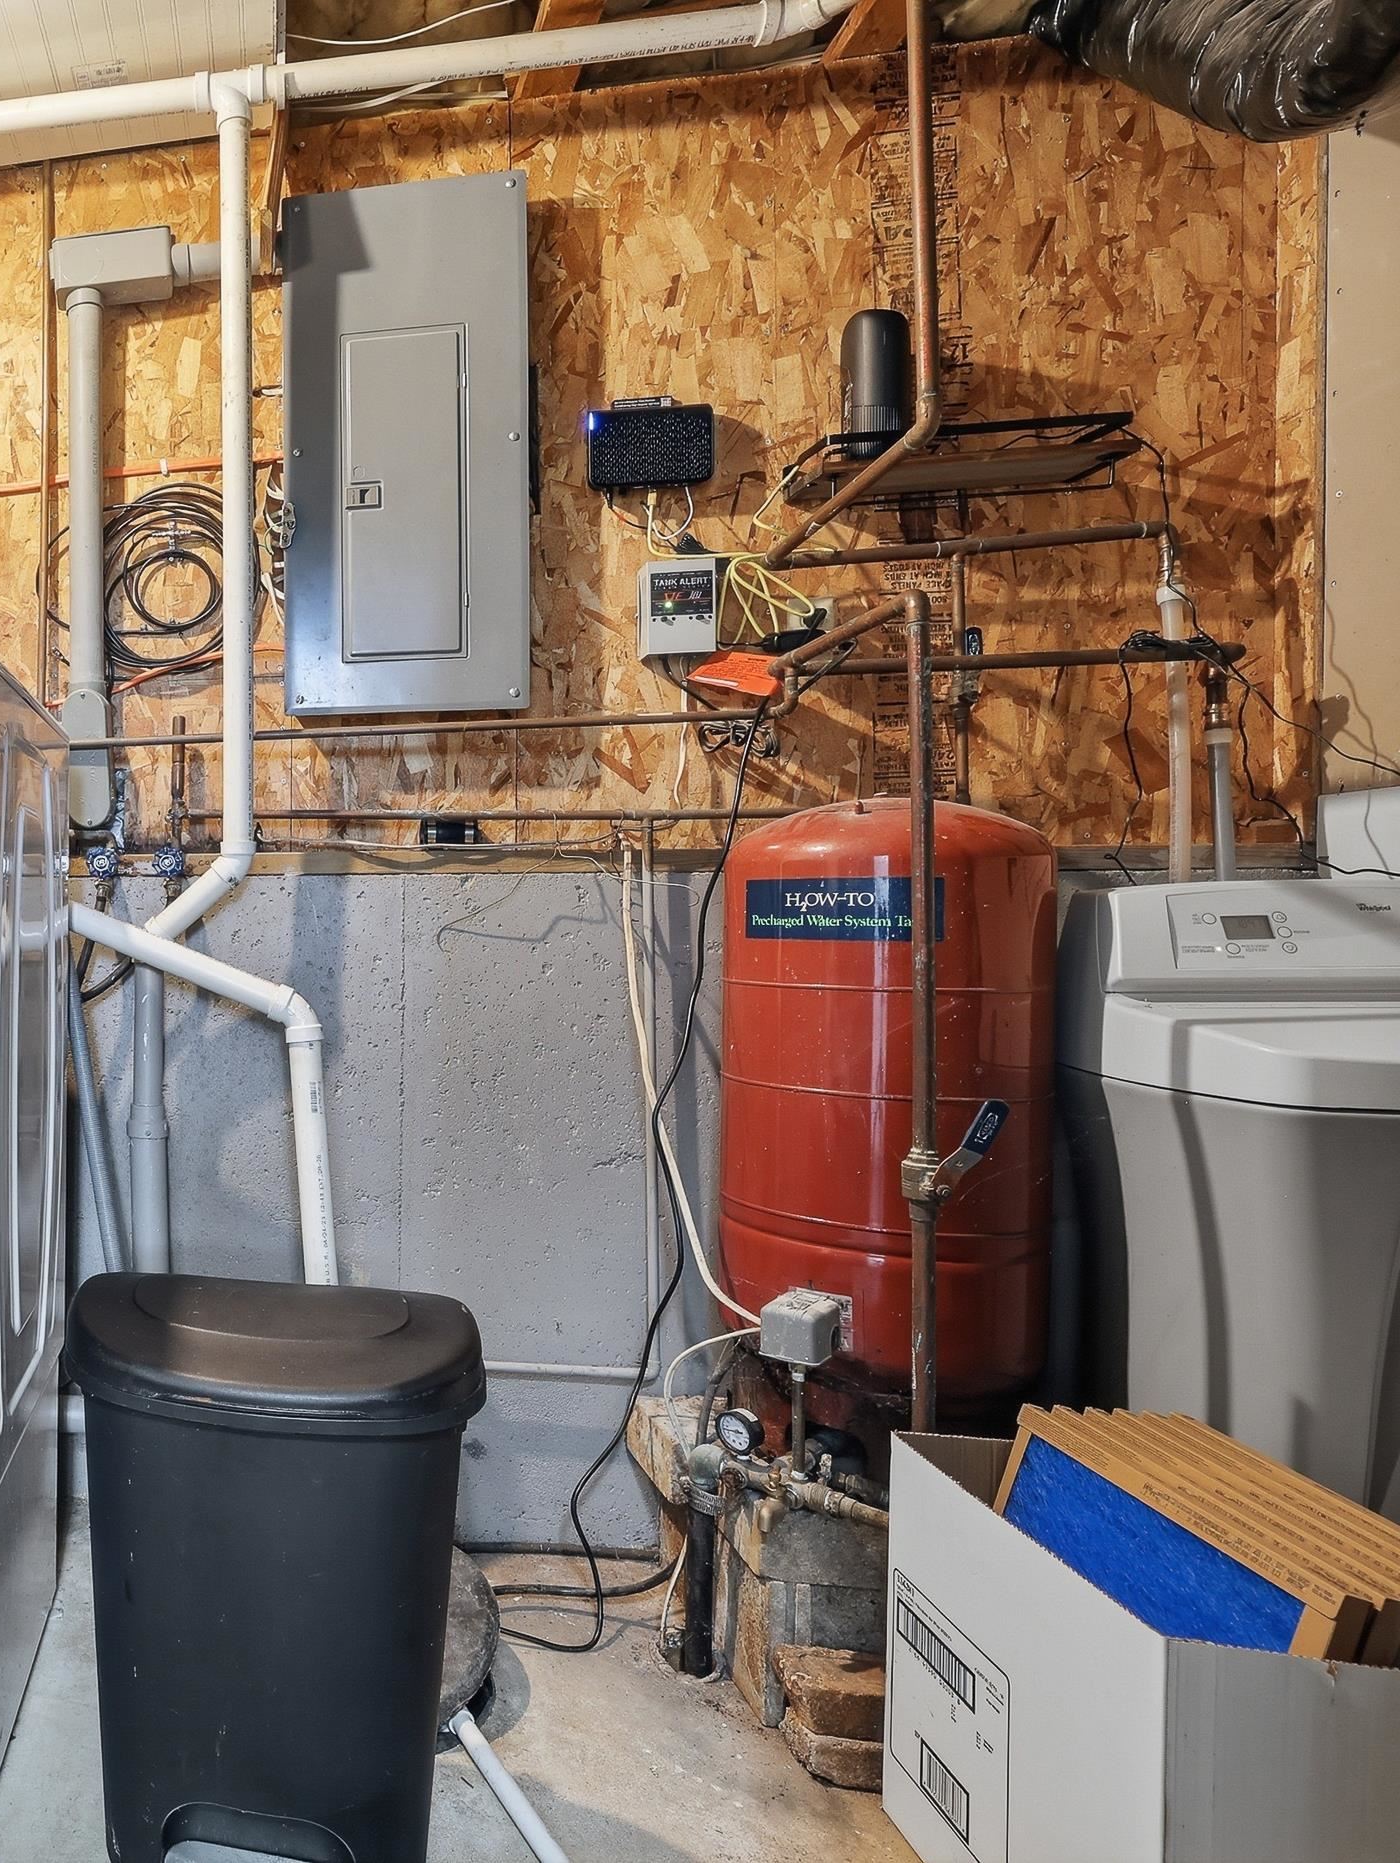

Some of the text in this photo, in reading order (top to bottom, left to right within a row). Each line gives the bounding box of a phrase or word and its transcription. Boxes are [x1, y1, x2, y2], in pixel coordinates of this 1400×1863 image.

[653, 576, 708, 587] TANK ALERT
[752, 914, 804, 929] Precharged
[807, 914, 841, 927] Water
[844, 914, 892, 930] System
